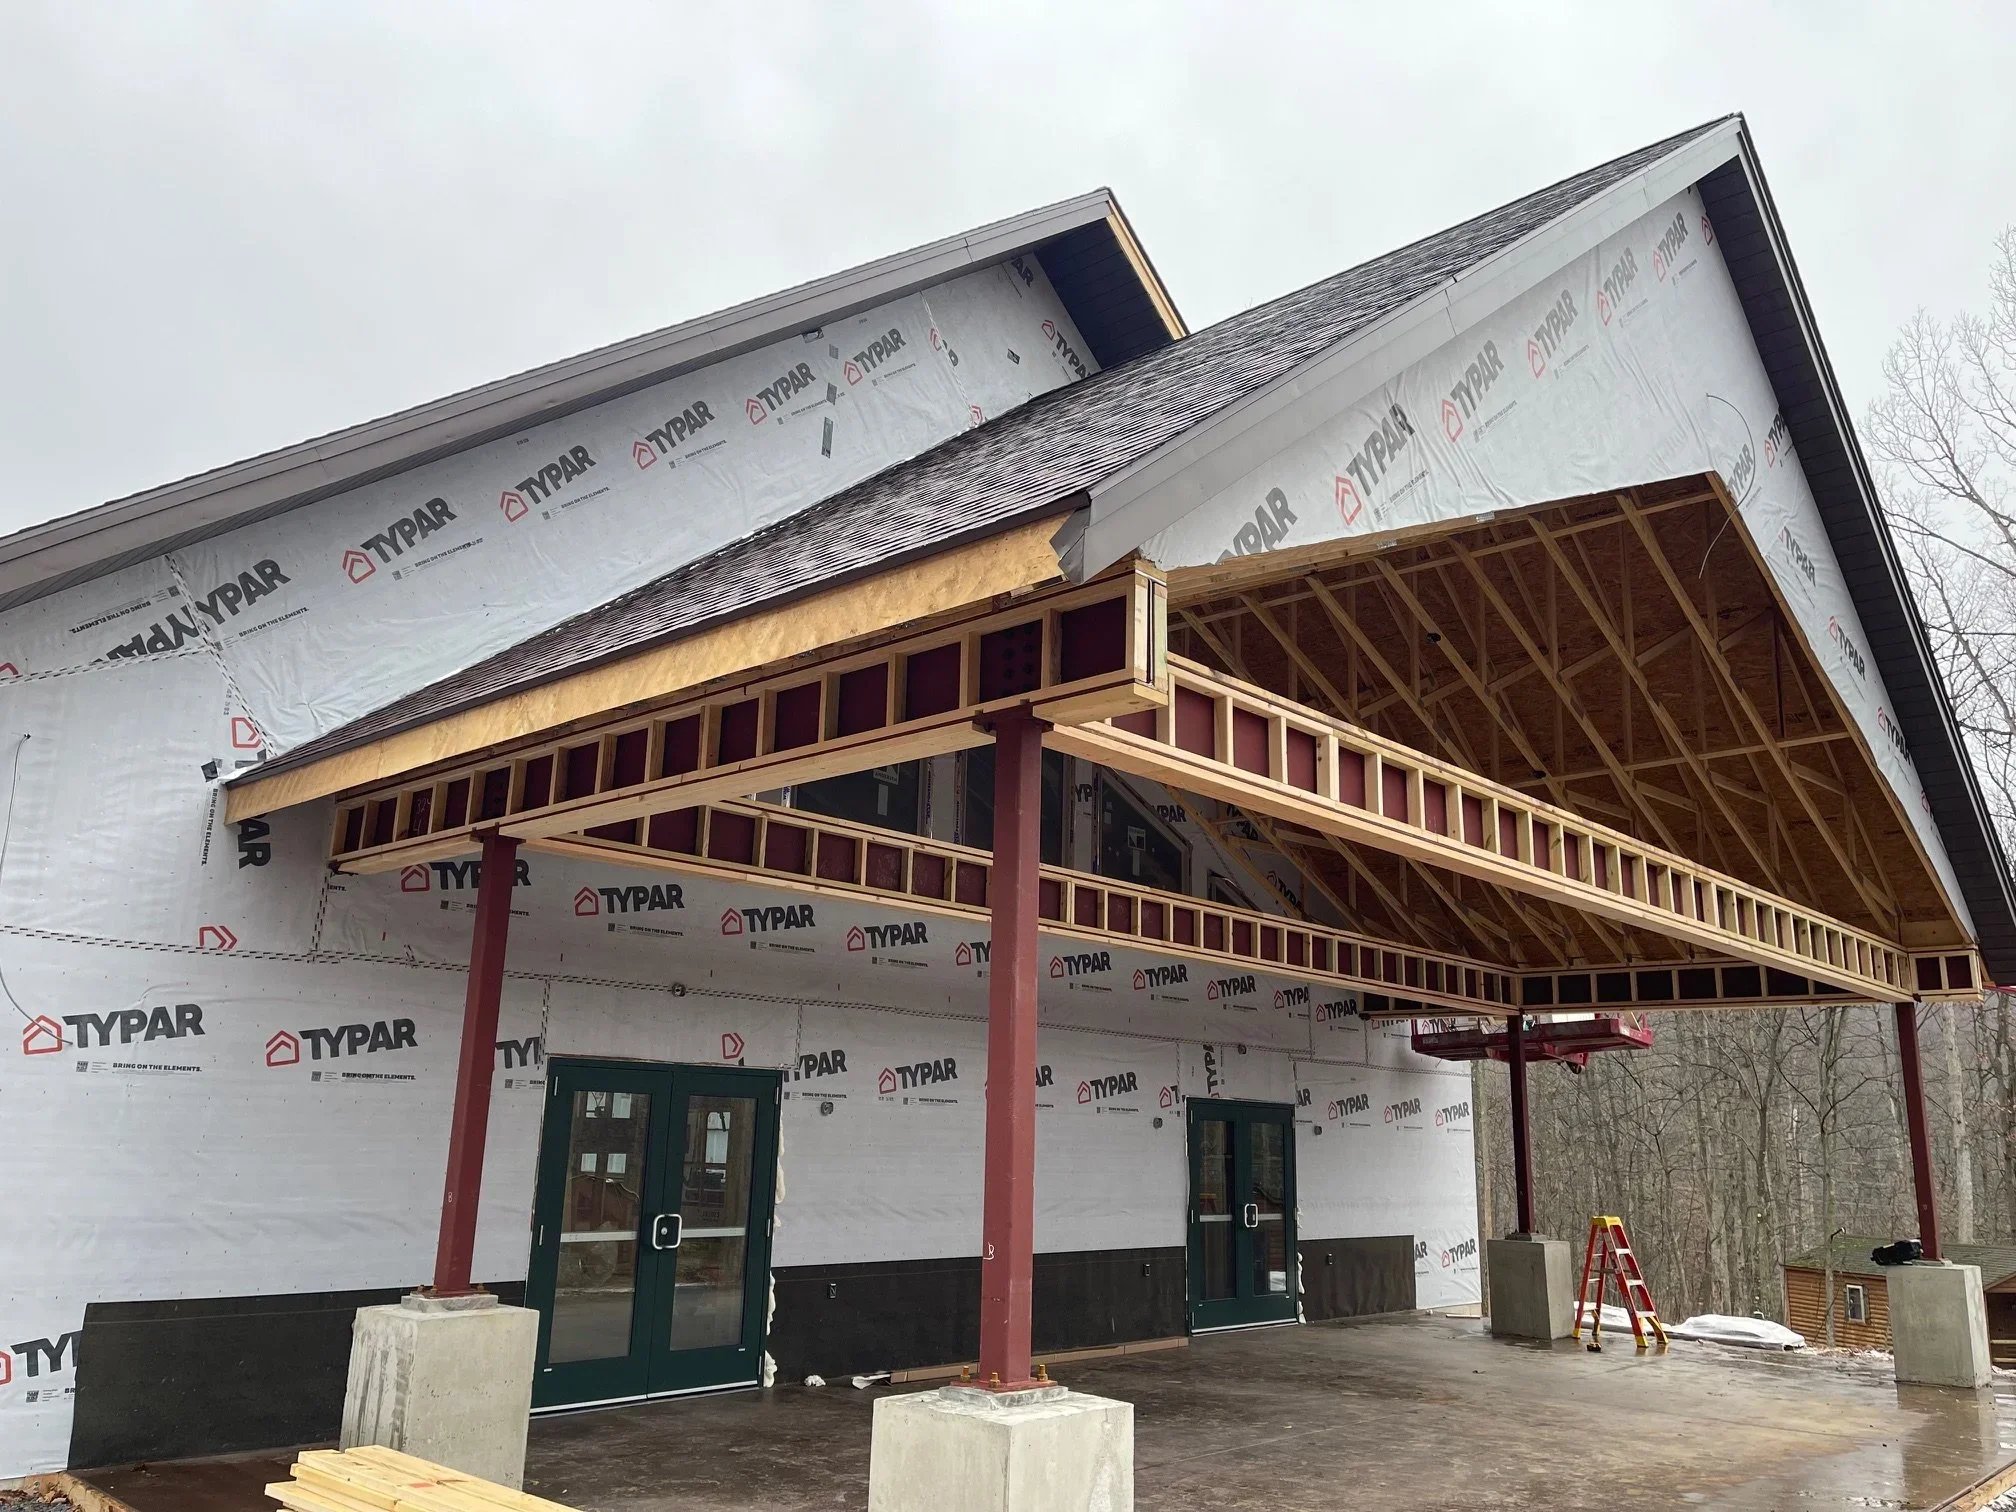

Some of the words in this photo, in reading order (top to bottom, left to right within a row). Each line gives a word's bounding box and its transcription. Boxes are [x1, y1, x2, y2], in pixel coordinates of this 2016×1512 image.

[1658, 212, 1688, 267] TYPAR
[1603, 247, 1638, 309] TYPAR
[1534, 289, 1578, 359] TYPAR
[853, 328, 907, 373] TYPAR
[1057, 330, 1092, 378] TYPA
[756, 362, 816, 411] TYPAR
[1450, 340, 1504, 420] TYPAR
[645, 401, 716, 454] TYPAR
[1346, 403, 1415, 496] TYPAR
[515, 445, 597, 505] TYPAR
[359, 498, 457, 564] TYPAR
[1784, 526, 1816, 587] TYPAR
[130, 601, 151, 612] BRING
[195, 559, 291, 631] YPAR
[68, 617, 107, 634] ELEMENTS.
[106, 612, 120, 621] THE
[119, 608, 130, 617] ON
[239, 625, 257, 637] BRING
[257, 622, 267, 630] ON
[266, 619, 279, 627] THE
[278, 607, 309, 622] ELEMENTS.
[1837, 625, 1866, 681] TYPAR
[209, 808, 215, 818] ON
[210, 788, 218, 808] BRING
[206, 819, 214, 831] THE
[201, 831, 211, 866] ELEMENTS.
[429, 859, 531, 890] TYPR
[598, 884, 685, 914] TYPAR
[741, 904, 816, 932] TYPAR
[864, 922, 928, 949] TYPAR
[1062, 952, 1111, 976] TYPAR
[1144, 964, 1188, 987] TYPAR
[1217, 975, 1256, 998] TYPAR
[1324, 998, 1358, 1020] TYPAR
[62, 1004, 205, 1048] TYPAR
[298, 1018, 418, 1060] TYPAR
[112, 1062, 136, 1070] BRING
[895, 1058, 958, 1089] TYPAR
[1090, 1072, 1138, 1100] TYPAR
[1336, 1093, 1369, 1117] TYPAR
[1391, 1098, 1422, 1121] TYPAR
[1442, 1102, 1470, 1124] TYPAR
[1449, 1238, 1476, 1263] TYPAR
